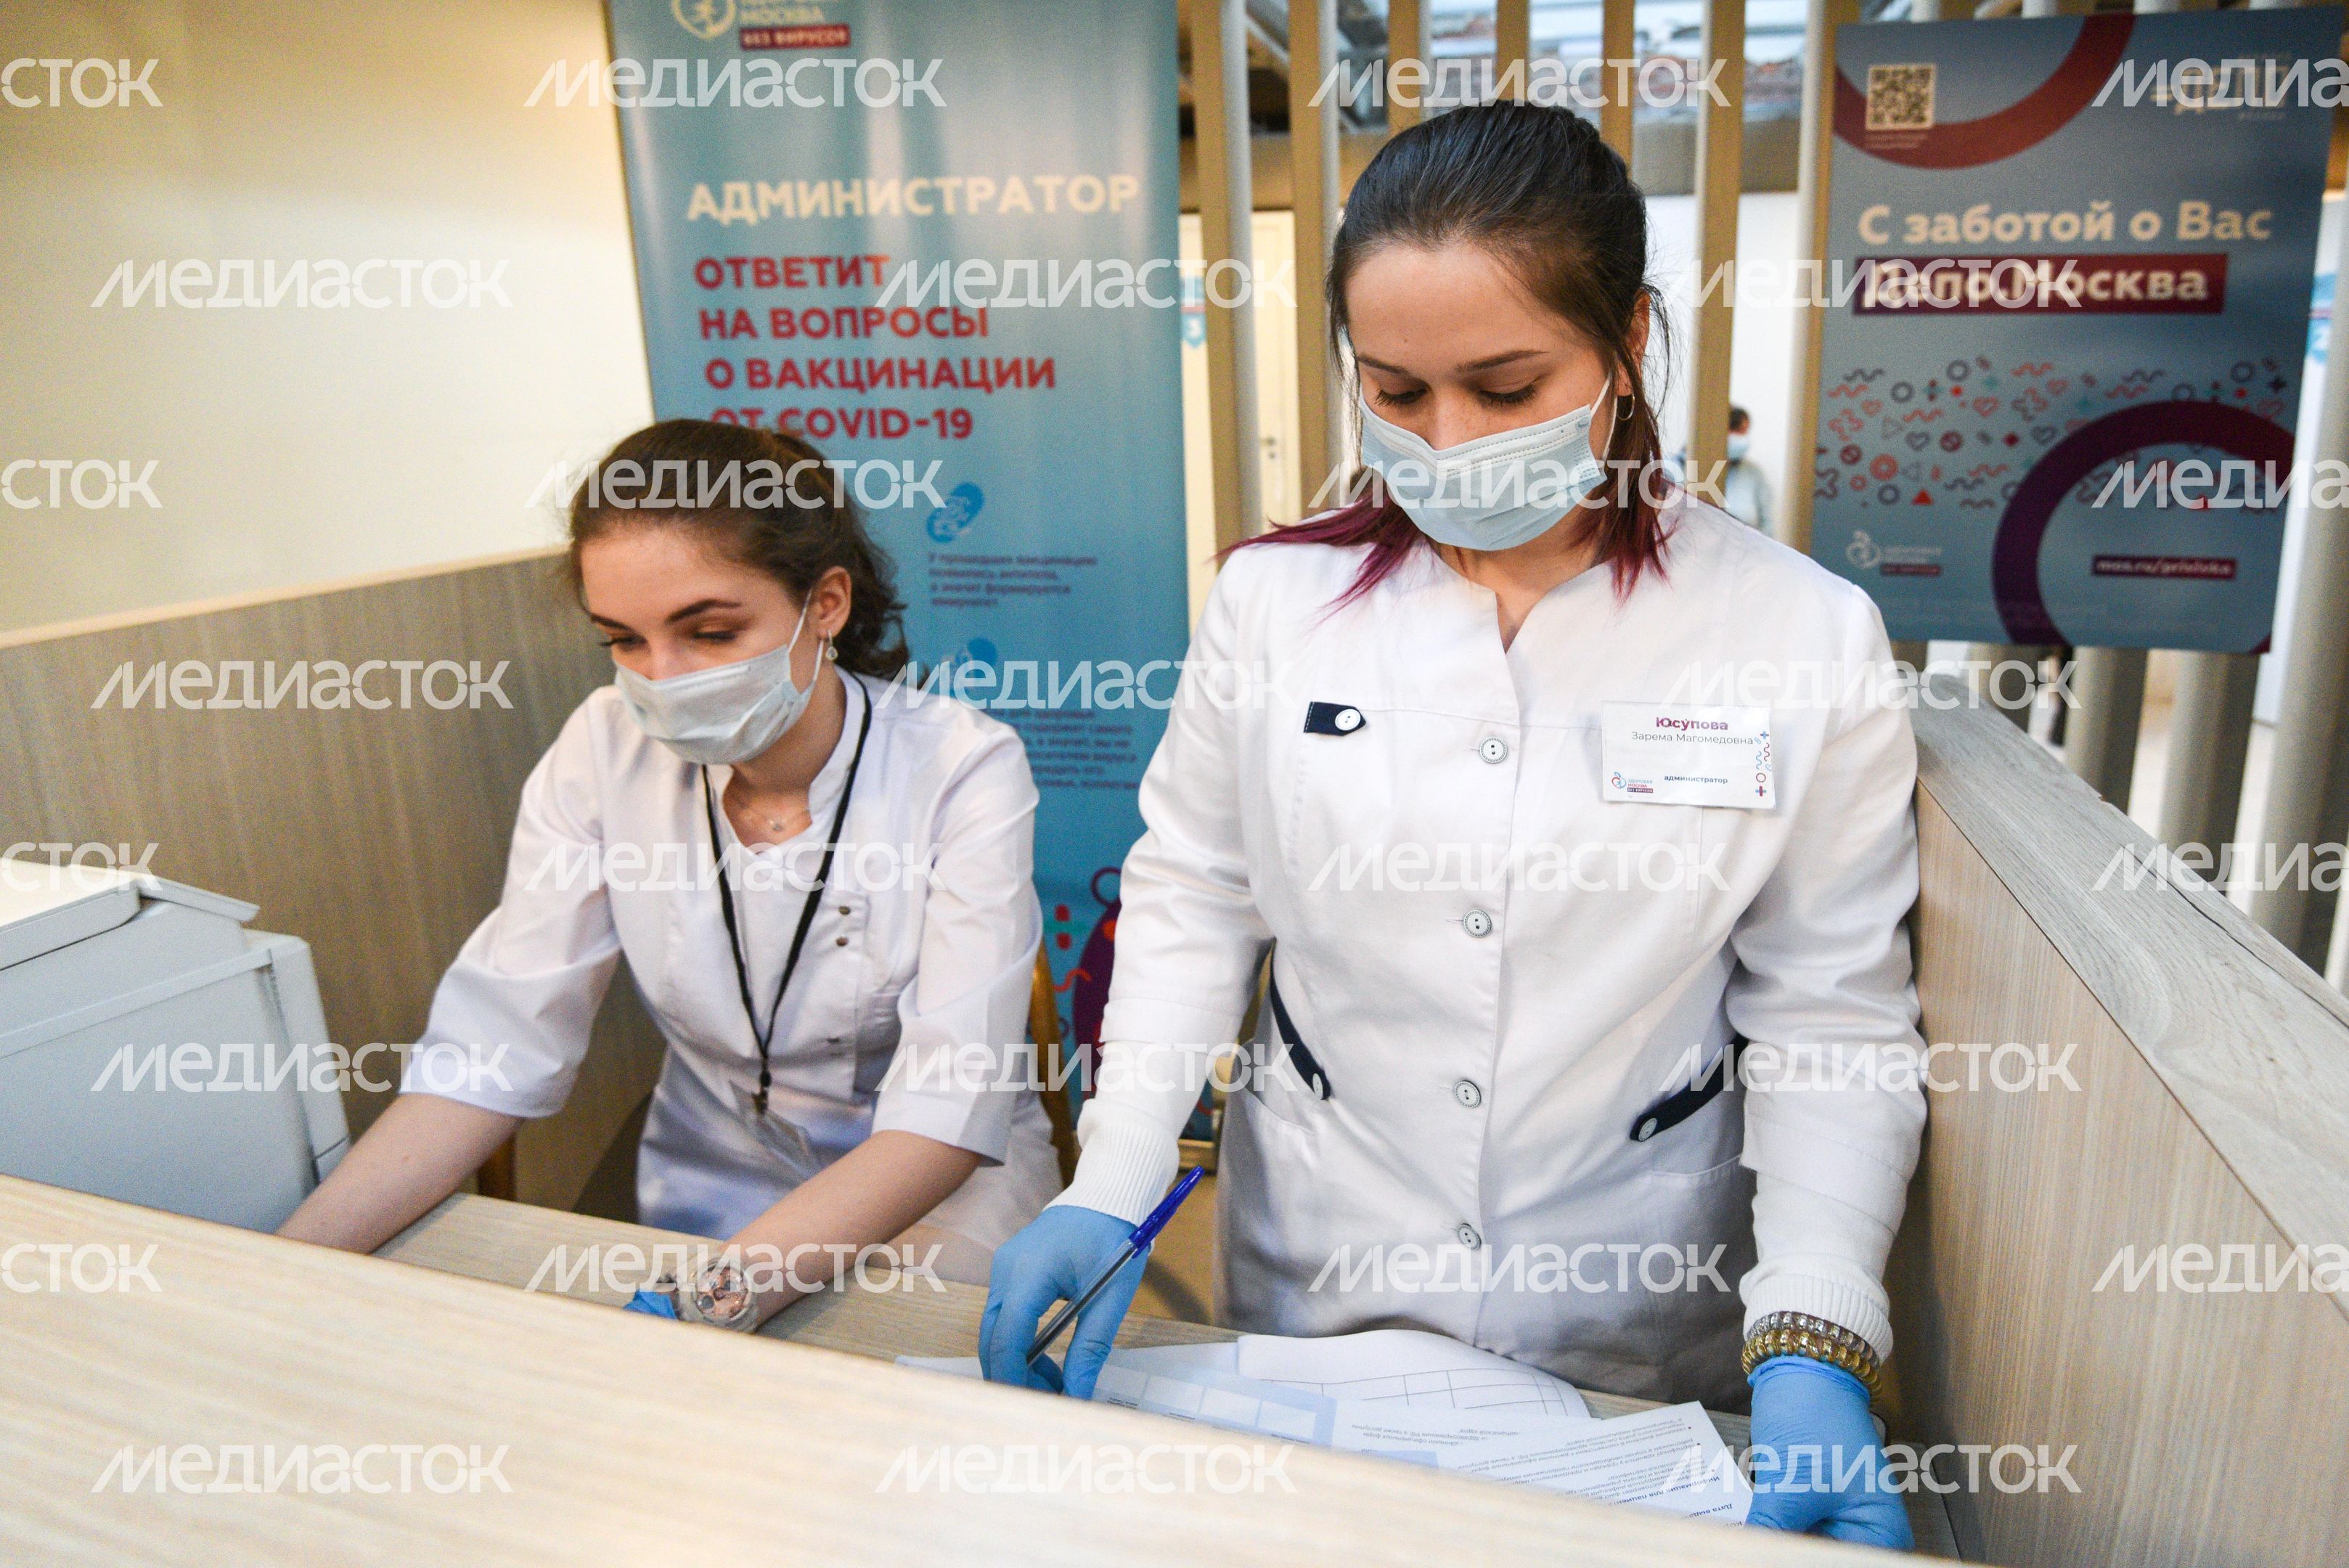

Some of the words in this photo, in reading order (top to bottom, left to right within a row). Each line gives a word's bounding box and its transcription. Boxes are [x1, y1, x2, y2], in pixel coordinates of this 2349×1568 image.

[687, 173, 1140, 226] АДМИНИСТРАТОР
[1858, 207, 1890, 246] С
[1903, 200, 2114, 245] заботой
[2130, 208, 2163, 241] о
[2176, 201, 2273, 240] Вас
[693, 254, 891, 291] ОТВЕТИТ
[700, 308, 757, 341] НА
[770, 306, 989, 340] ВОПРОСЫ
[706, 359, 736, 392] О
[747, 355, 1056, 394] ВАКЦИНАЦИИ
[779, 406, 973, 440] COVID-19
[1632, 732, 1672, 743] Зарема
[1676, 733, 1753, 745] Магомедовна
[1656, 717, 1728, 731] Юсупова
[1664, 775, 1728, 784] администратор
[1666, 1477, 1720, 1494] Информация
[1712, 1503, 1733, 1512] Дата
